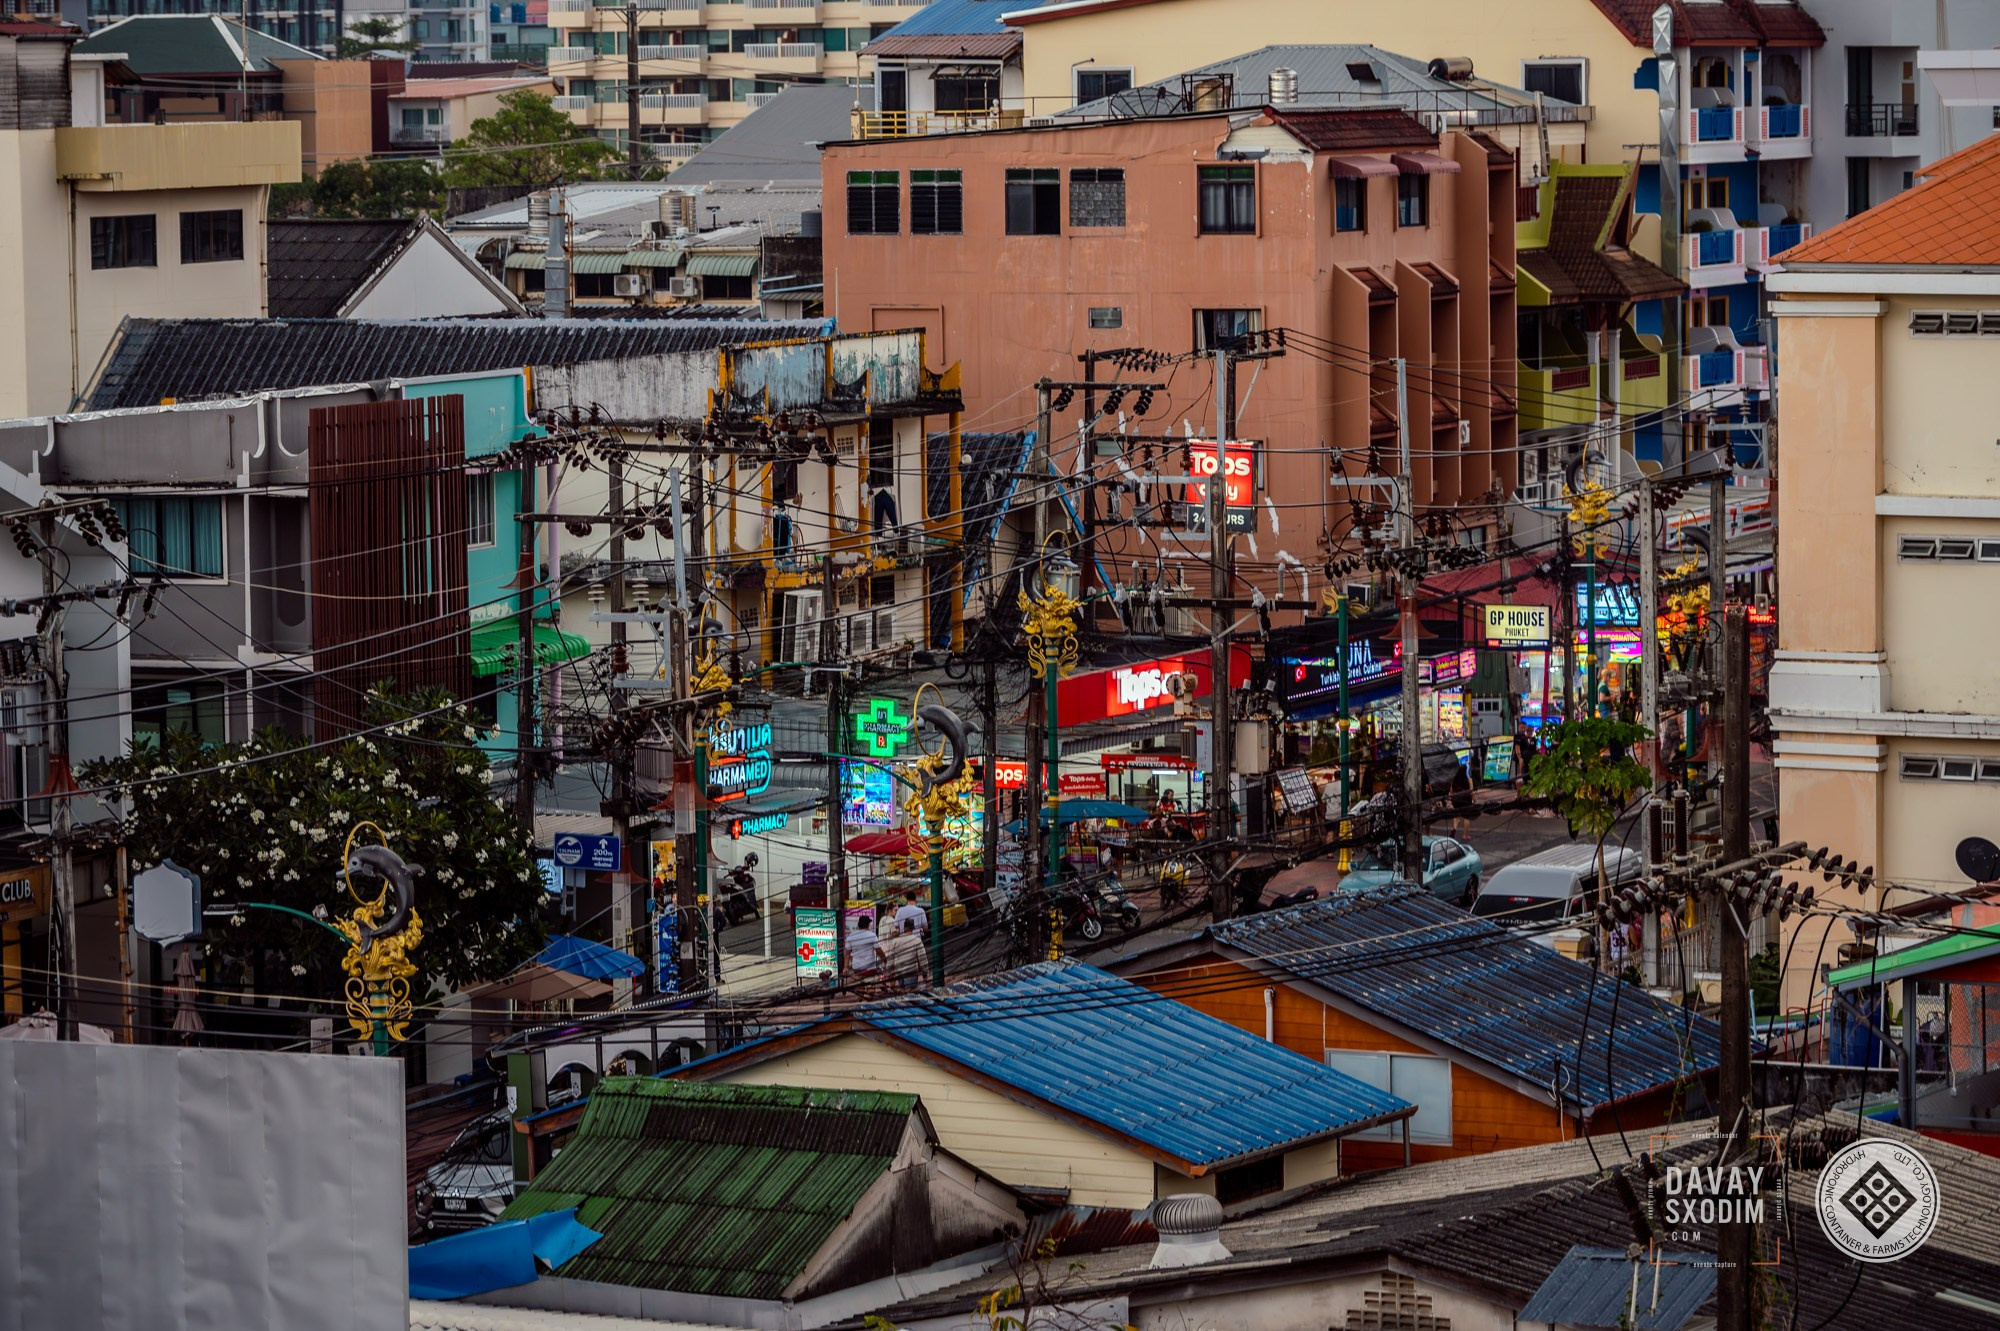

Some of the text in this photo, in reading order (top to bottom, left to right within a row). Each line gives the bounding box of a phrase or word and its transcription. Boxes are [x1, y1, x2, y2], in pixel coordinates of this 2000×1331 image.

[1490, 610, 1545, 627] GP HOUSE
[1505, 628, 1530, 637] PHUKET
[1113, 667, 1161, 710] Tops
[863, 723, 901, 734] PHARMACY
[710, 759, 768, 787] HARMAMED
[995, 768, 1022, 785] ops
[742, 812, 788, 836] PHARMACY
[797, 929, 835, 937] PHARMACY
